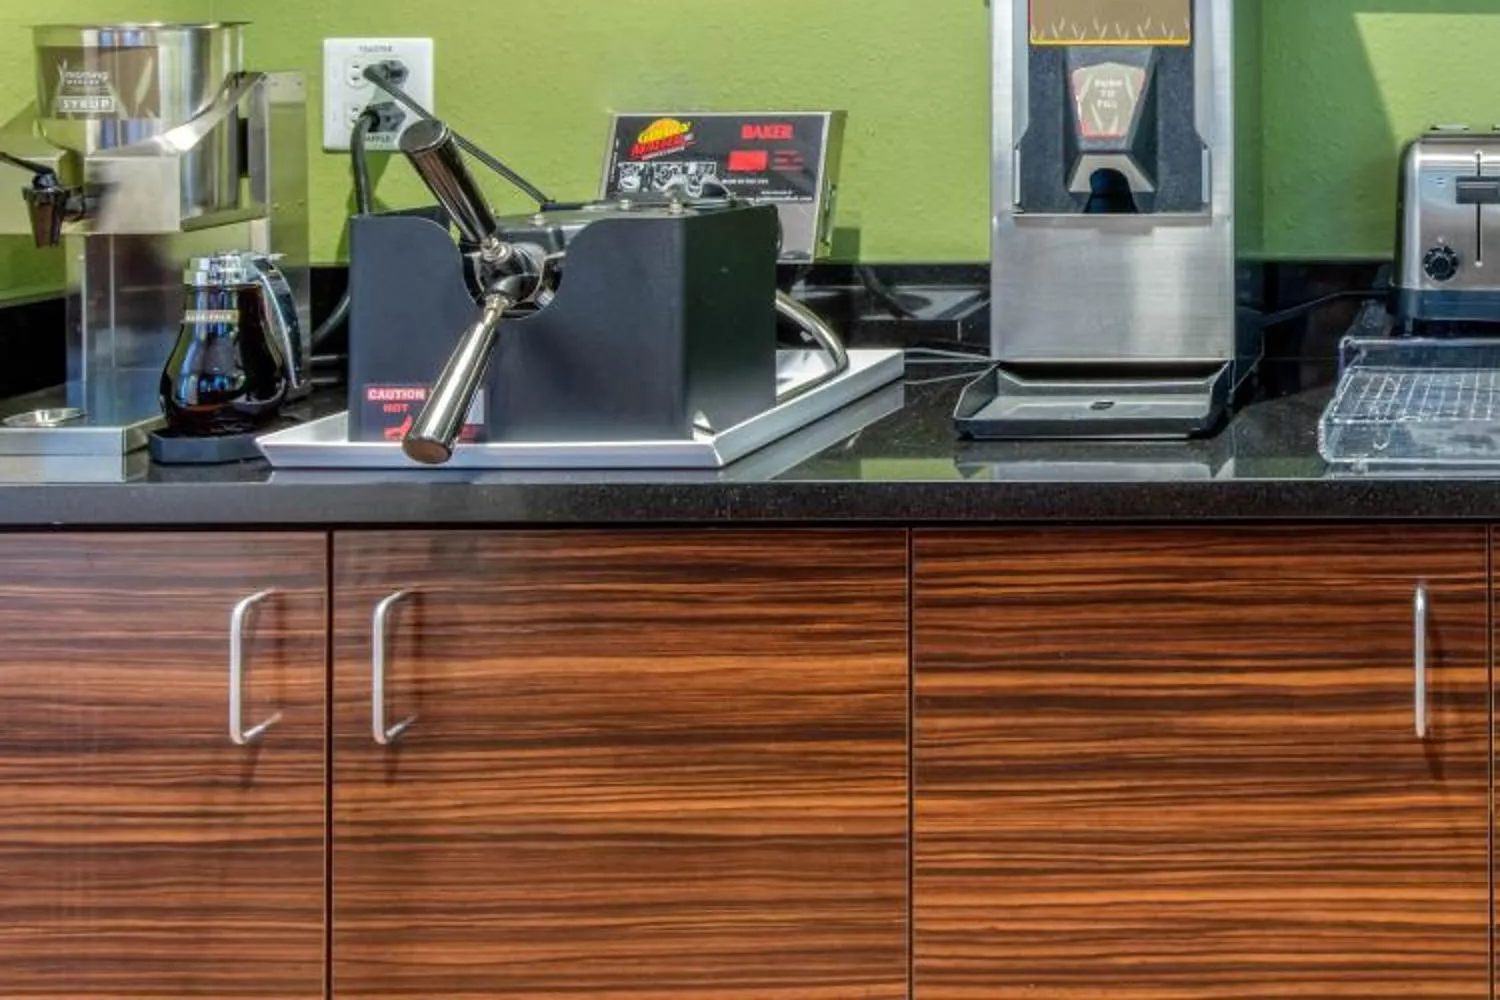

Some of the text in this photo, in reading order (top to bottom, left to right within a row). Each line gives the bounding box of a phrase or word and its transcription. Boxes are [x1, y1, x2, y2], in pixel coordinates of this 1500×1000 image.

[63, 99, 110, 109] SYRUP
[742, 123, 794, 140] BAKER
[367, 388, 426, 401] CAUTION
[383, 403, 409, 413] HOT
